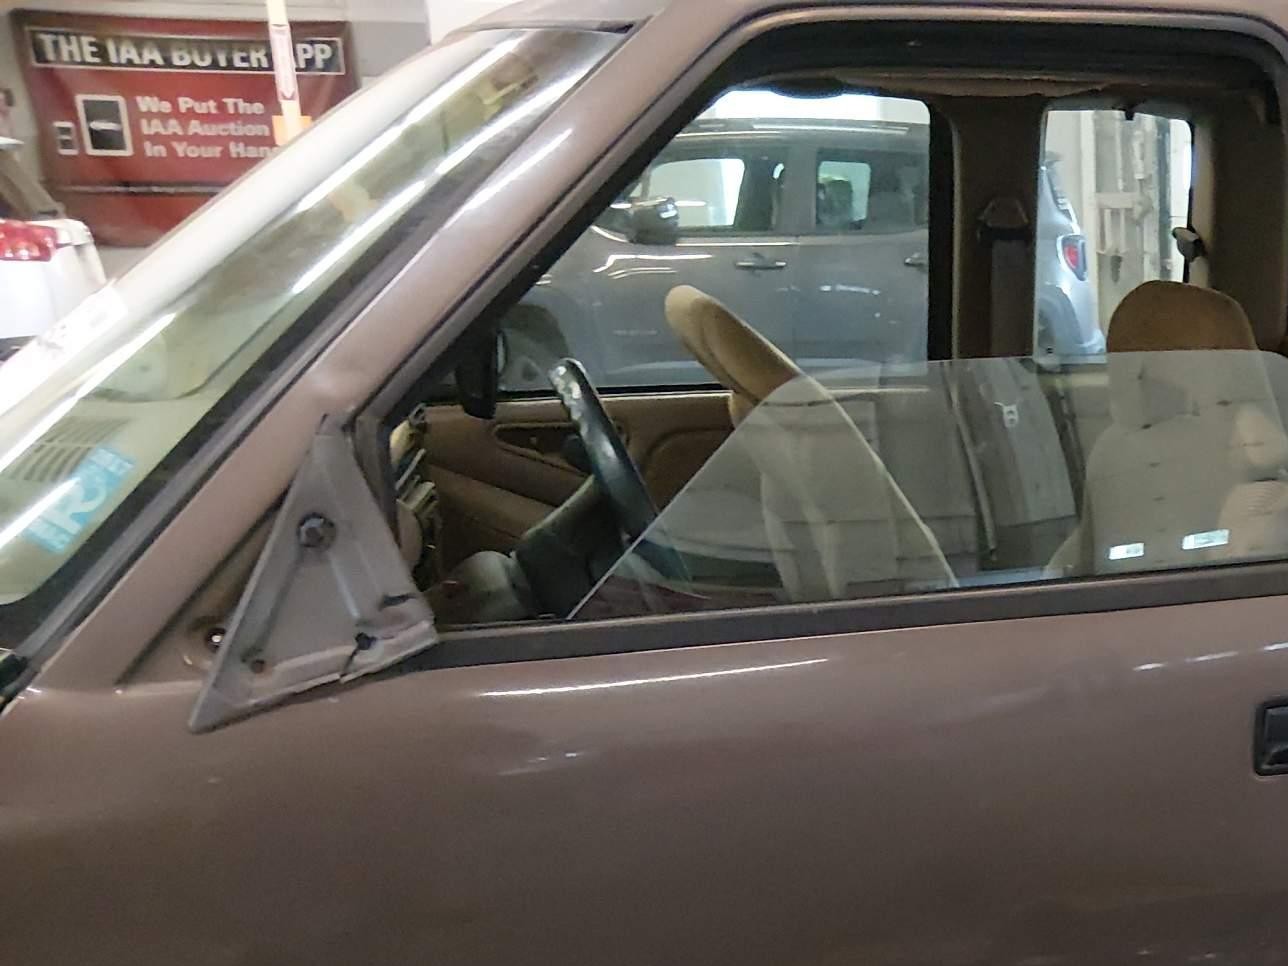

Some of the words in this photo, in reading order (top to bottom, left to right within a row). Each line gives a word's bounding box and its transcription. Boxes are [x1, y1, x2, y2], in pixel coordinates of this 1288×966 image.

[38, 33, 102, 63] THE
[105, 38, 165, 65] IAA
[294, 43, 333, 69] PP
[136, 96, 172, 113] We
[176, 97, 219, 114] Put
[222, 98, 265, 114] The
[141, 119, 184, 136] IAA
[188, 119, 270, 136] Auction
[143, 141, 167, 157] In
[171, 141, 223, 158] Your
